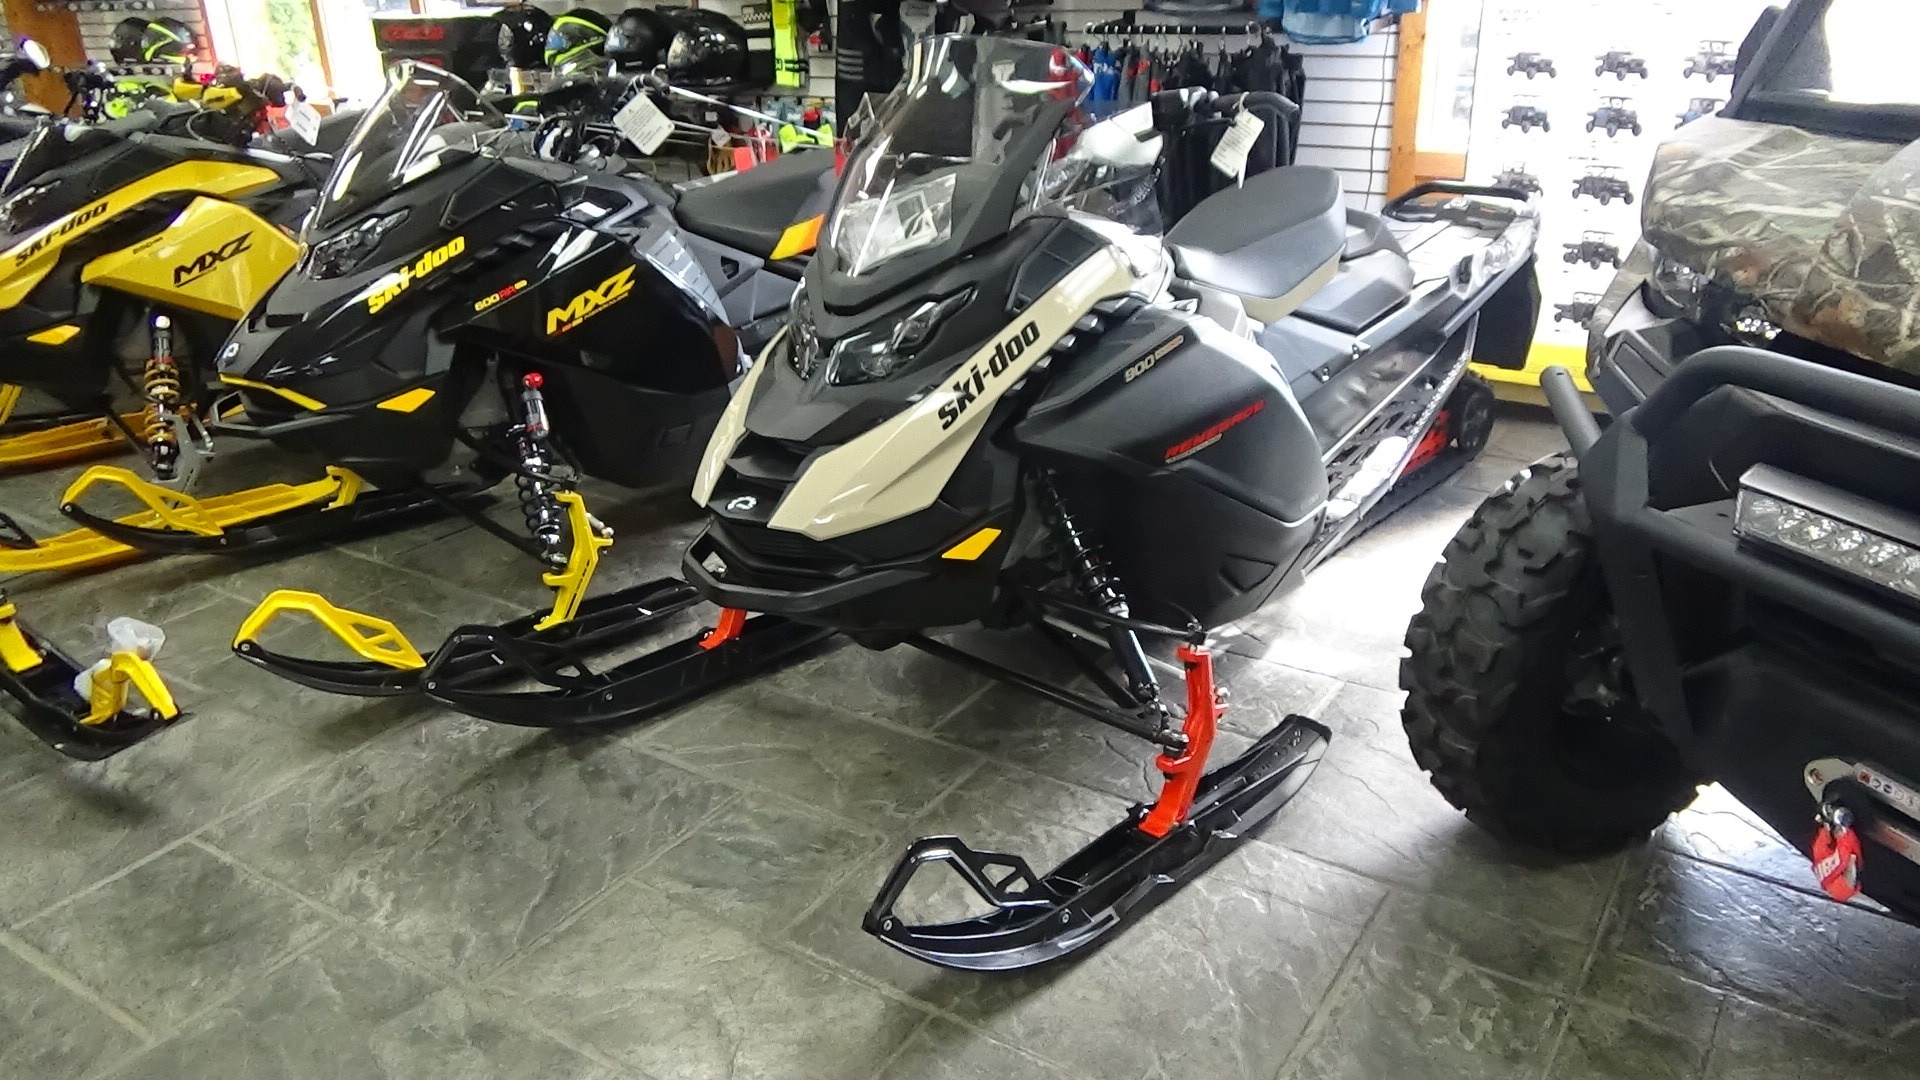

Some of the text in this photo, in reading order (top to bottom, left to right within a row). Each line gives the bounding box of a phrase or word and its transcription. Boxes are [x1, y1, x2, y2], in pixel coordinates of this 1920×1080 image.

[173, 230, 253, 286] MXZ
[546, 264, 636, 335] MXZ
[1124, 354, 1156, 383] 900
